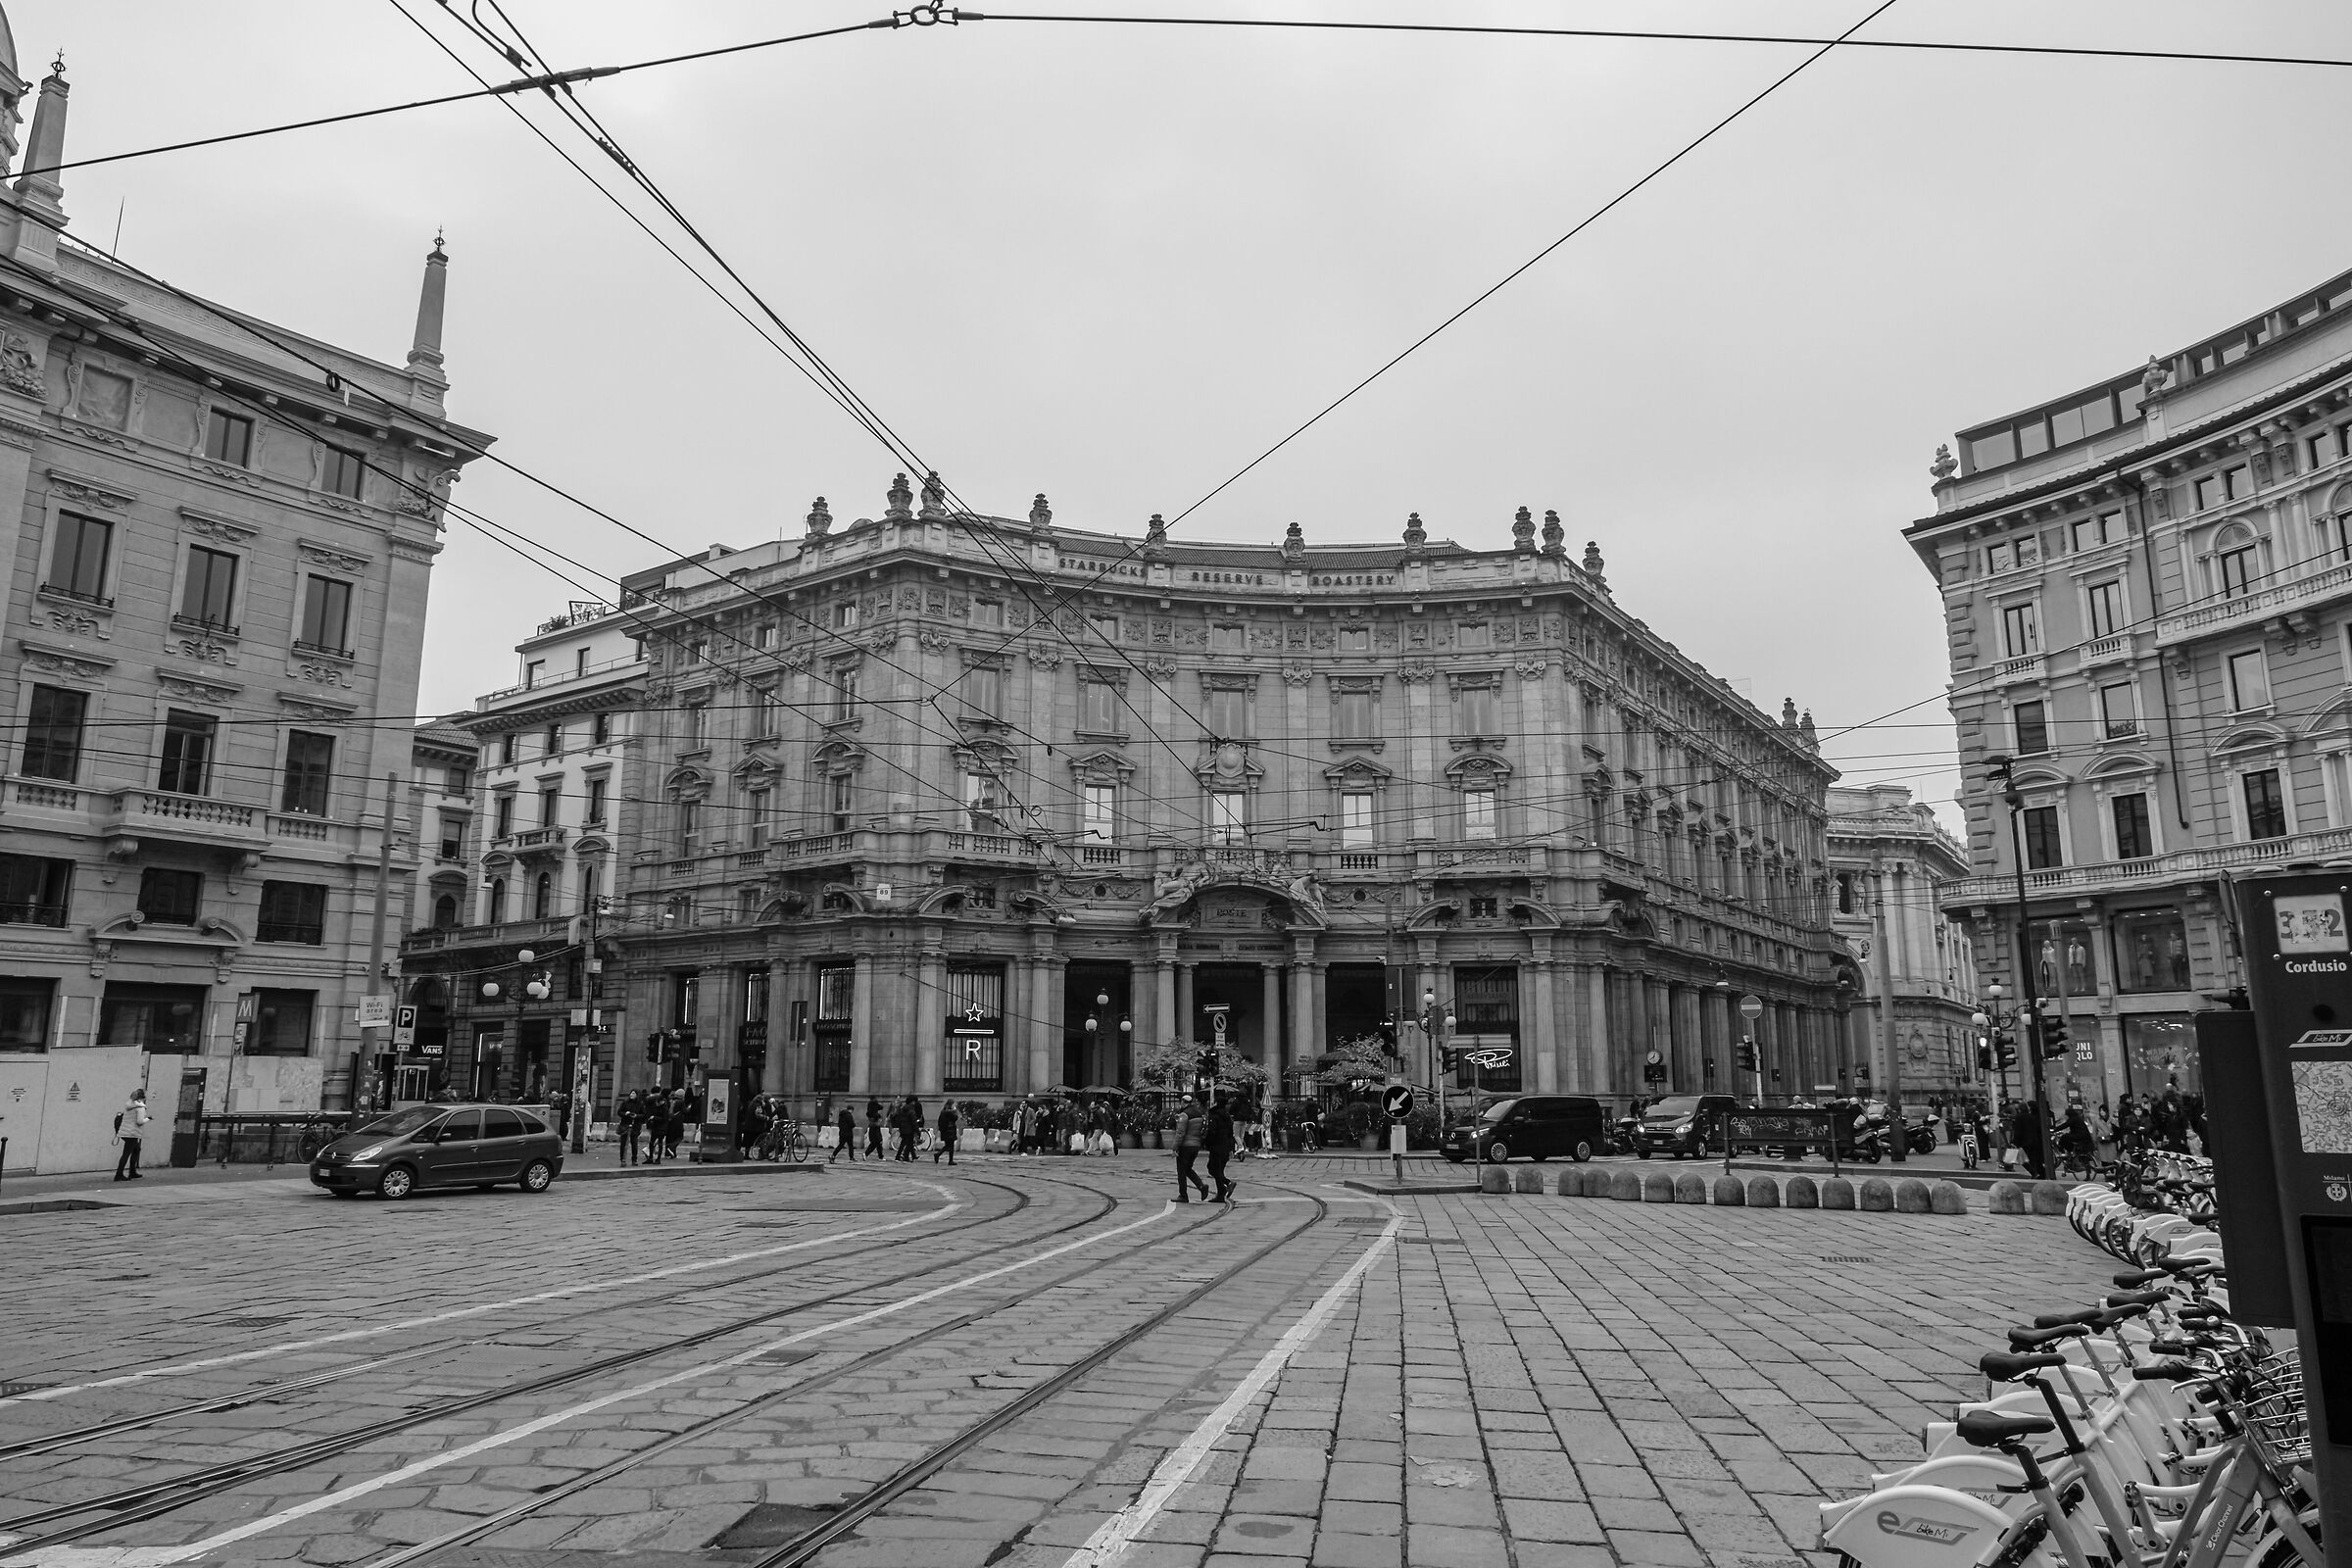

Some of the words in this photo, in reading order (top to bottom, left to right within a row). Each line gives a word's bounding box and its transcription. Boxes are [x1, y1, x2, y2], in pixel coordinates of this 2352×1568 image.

[1059, 557, 1147, 578] STARBUCKS
[1192, 571, 1263, 585] RESERVE
[1311, 575, 1395, 586] ROASTERY
[1216, 908, 1248, 917] POSTE
[2285, 959, 2347, 973] Cordusio
[237, 1000, 252, 1017] M
[401, 1009, 412, 1026] P
[421, 1045, 443, 1054] VANS
[966, 1040, 981, 1059] R
[2210, 1527, 2222, 1543] Clear
[2218, 1503, 2233, 1528] Channel
